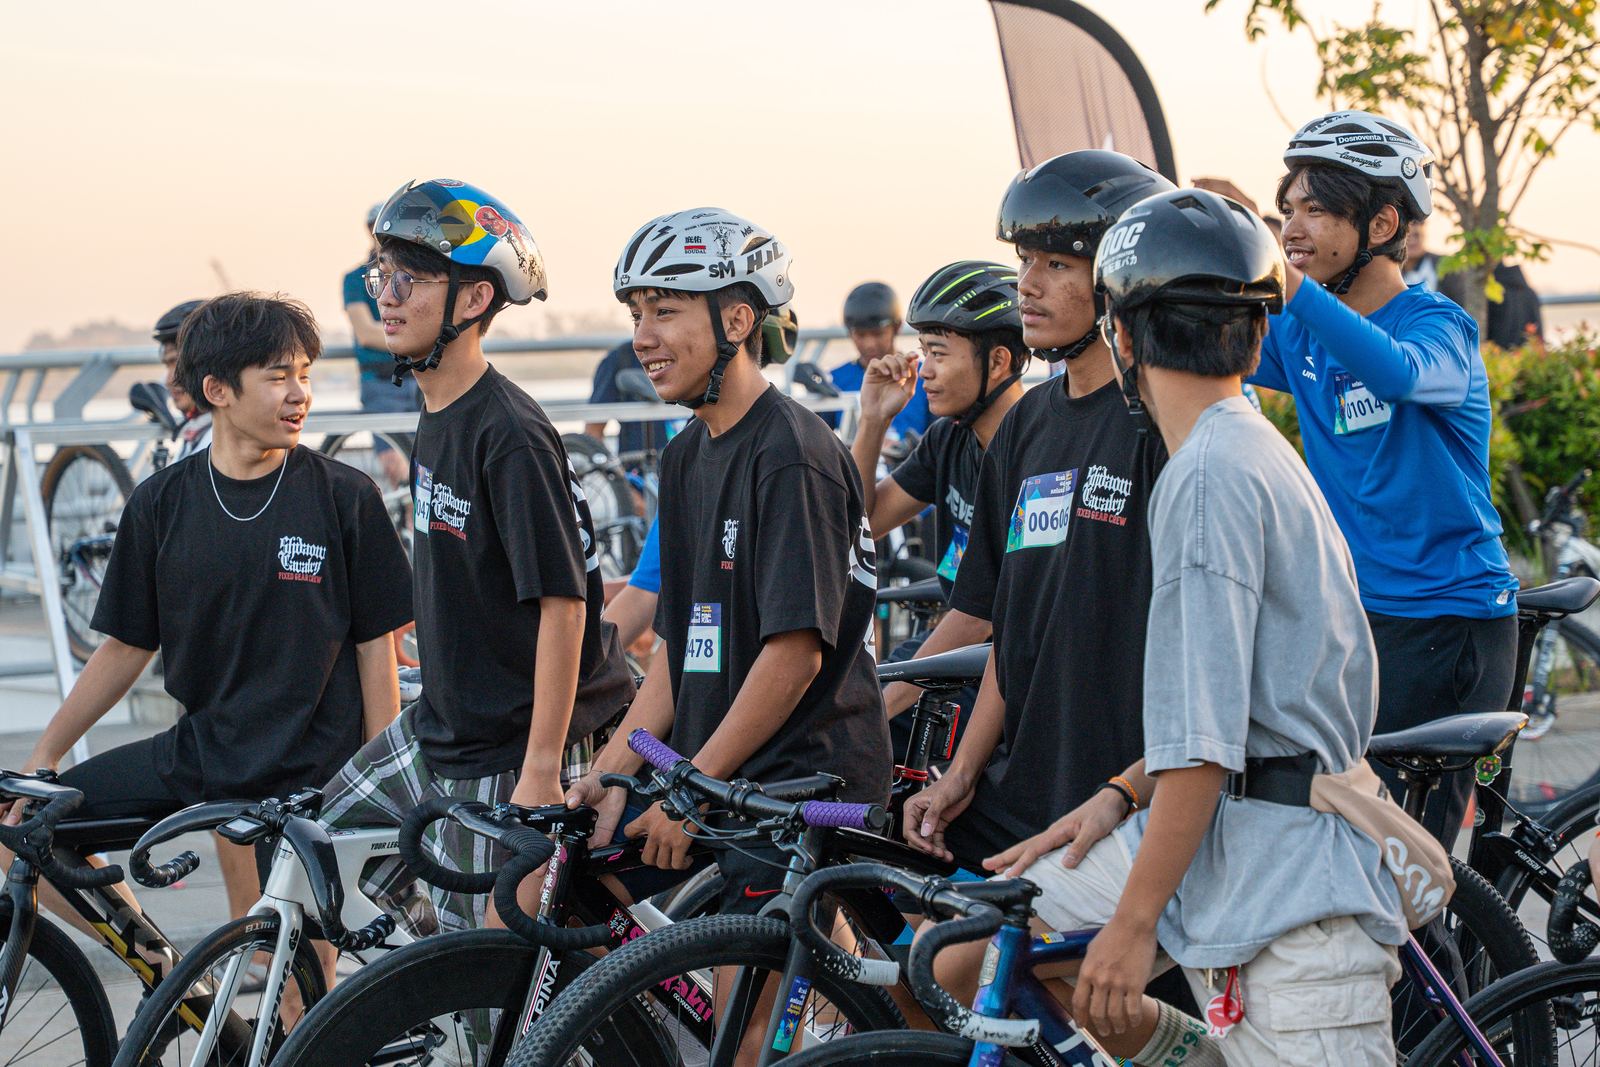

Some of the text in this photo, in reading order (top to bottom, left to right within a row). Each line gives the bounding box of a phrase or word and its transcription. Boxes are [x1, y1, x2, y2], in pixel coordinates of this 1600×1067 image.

[1338, 134, 1381, 144] Dosnoventa
[1335, 151, 1383, 169] Campagnolo
[708, 260, 736, 279] SM
[1346, 398, 1385, 420] 01014
[430, 521, 448, 531] FIXED
[1028, 506, 1070, 533] 00606
[1076, 507, 1127, 526] FIXED GEAR CREW
[278, 572, 322, 584] FIXED GEAR CREW
[370, 842, 387, 850] YOUR
[1514, 849, 1548, 876] Kansai 2
[530, 960, 561, 1027] PINA
